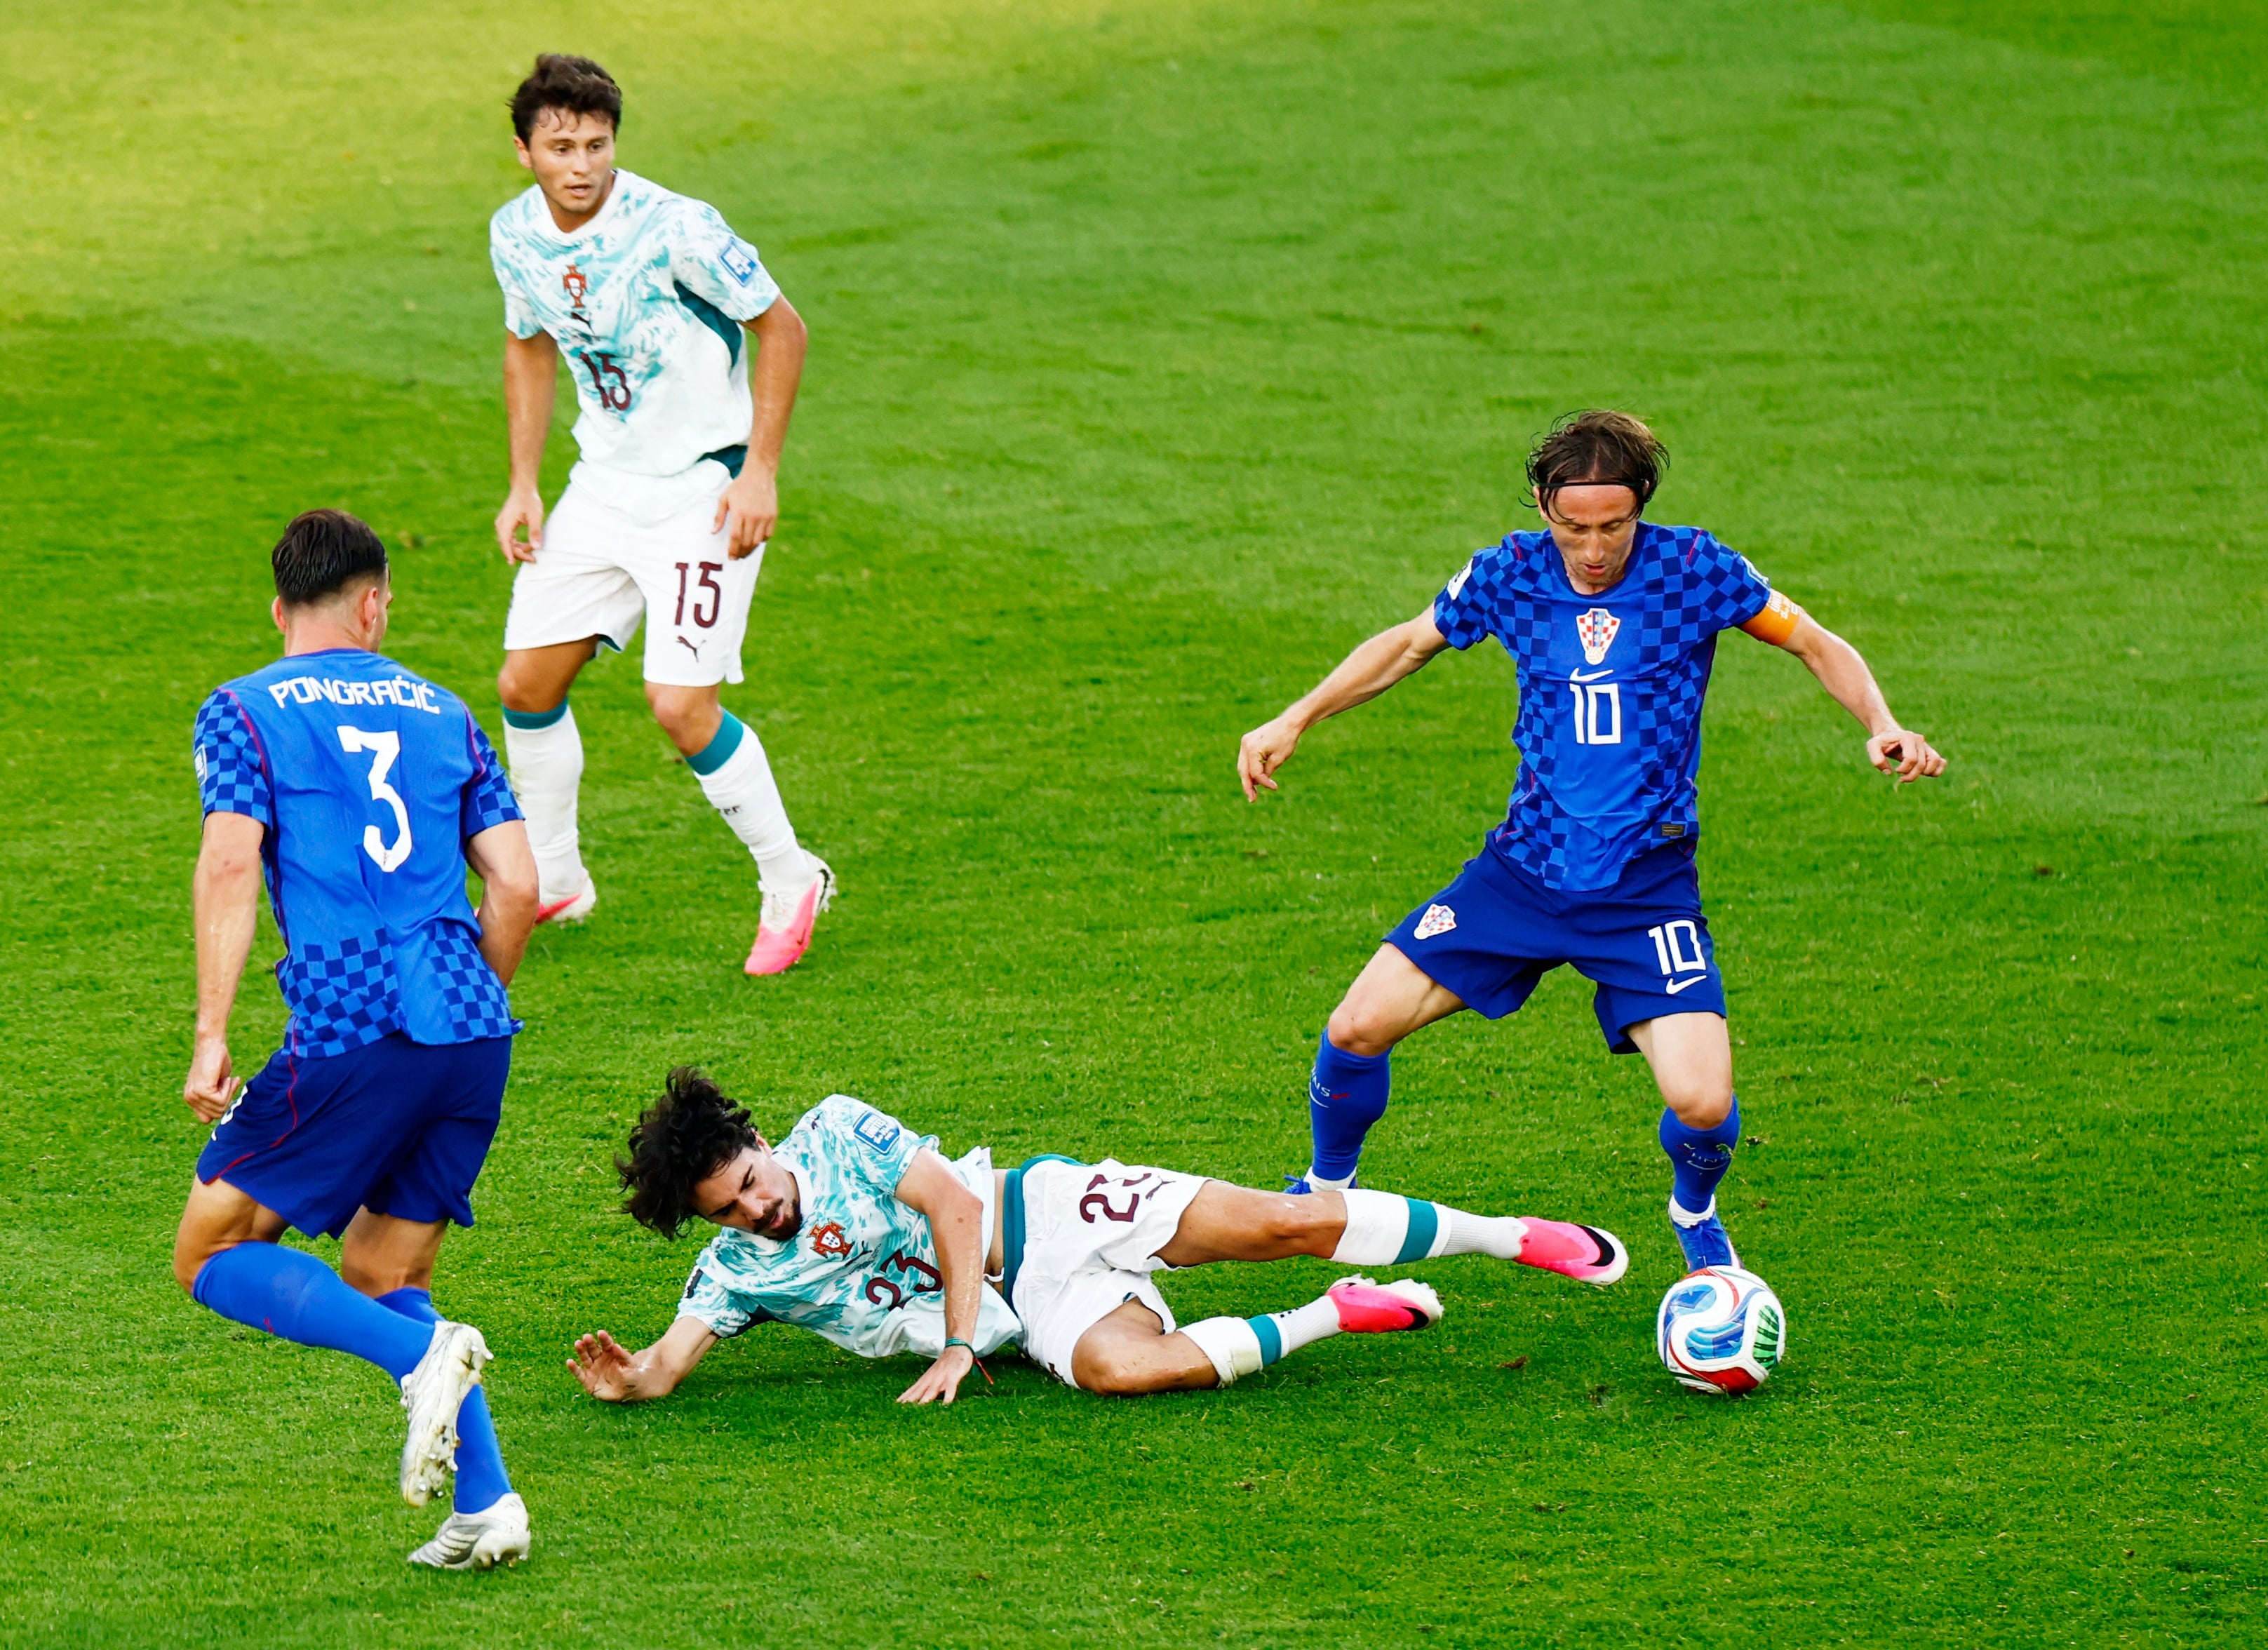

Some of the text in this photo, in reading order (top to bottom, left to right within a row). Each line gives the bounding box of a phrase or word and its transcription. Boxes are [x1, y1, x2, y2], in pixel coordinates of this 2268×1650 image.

[579, 351, 631, 410] 15
[675, 561, 723, 628] 15
[268, 675, 441, 714] PONGRAČIĆ
[1569, 683, 1621, 745] 10
[337, 725, 412, 873] 3
[1648, 920, 1706, 975] 10
[865, 1249, 944, 1312] 23
